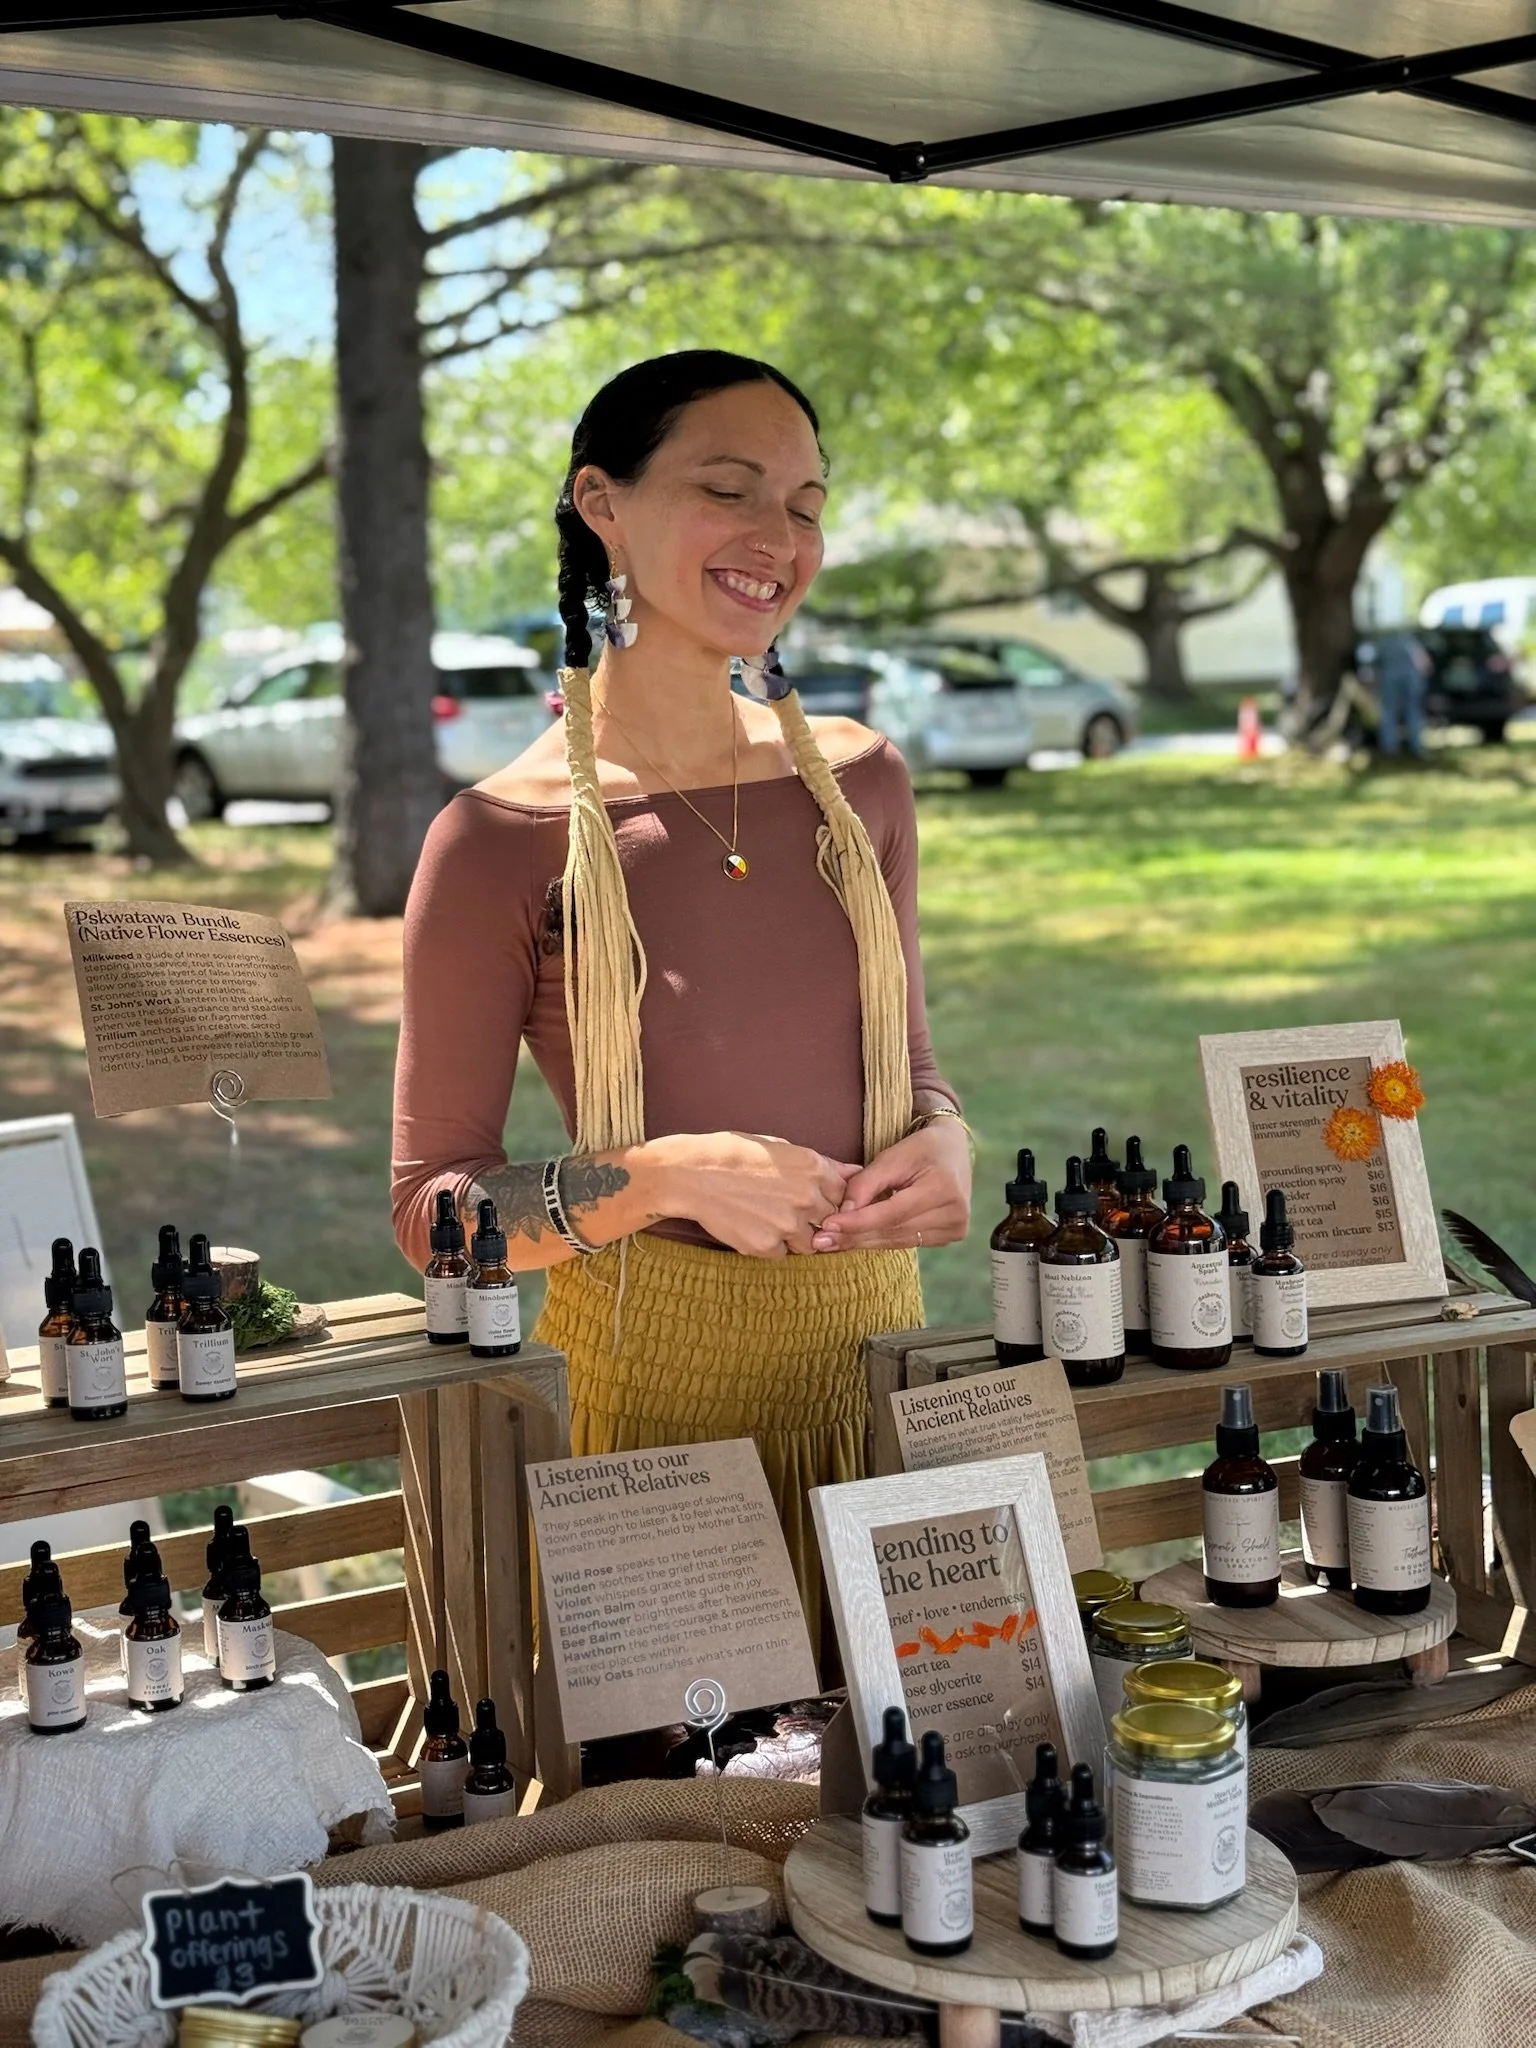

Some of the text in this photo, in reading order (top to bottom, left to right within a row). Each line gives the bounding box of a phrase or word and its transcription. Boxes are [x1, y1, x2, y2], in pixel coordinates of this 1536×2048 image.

[75, 910, 240, 929] Pskwatawa Bundle
[78, 926, 285, 948] (Native Flower Essences)
[82, 952, 133, 963] Milkweed
[145, 952, 172, 961] guide
[175, 951, 184, 959] of
[186, 951, 210, 959] inner
[90, 1003, 105, 1012] St.
[107, 1000, 142, 1010] John's
[145, 998, 172, 1006] Wort
[182, 996, 216, 1004] lantern
[220, 995, 229, 1003] in
[96, 1031, 138, 1042] Trillium
[140, 1026, 180, 1036] anchors
[251, 1022, 281, 1030] sacred
[1245, 1066, 1351, 1089] resilience
[1250, 1086, 1348, 1111] & vitality
[1252, 1116, 1320, 1130] inner strength
[1253, 1129, 1301, 1140] immunity
[1261, 1164, 1312, 1179] grounding
[1314, 1163, 1342, 1173] spray
[1263, 1170, 1385, 1192] protection spray $16
[1370, 1183, 1387, 1193] $16
[1300, 1196, 1389, 1214] oxymel $16
[1307, 1208, 1392, 1225] tea $15
[1332, 1226, 1371, 1237] tincture
[1378, 1221, 1395, 1232] $13
[193, 1339, 229, 1349] Trillium
[91, 1355, 113, 1363] Wort
[900, 1378, 1017, 1416] Listening to our
[905, 1393, 1032, 1434] Ancient Relatives
[909, 1407, 1056, 1448] Teachers in what true vitality feels like
[534, 1453, 689, 1488] Listening to our
[540, 1470, 711, 1510] Ancient Relatives
[543, 1493, 744, 1532] They speak in the language of slowing
[873, 1523, 1008, 1565] tending to
[552, 1570, 580, 1585] Wild
[584, 1566, 613, 1579] Rose
[616, 1557, 655, 1573] speaks
[657, 1555, 669, 1565] to
[671, 1552, 690, 1562] the
[692, 1545, 728, 1559] tender
[880, 1554, 1000, 1597] the heart
[553, 1582, 596, 1598] Linden
[599, 1574, 645, 1589] soothes
[647, 1569, 666, 1580] the
[668, 1563, 693, 1578] grief
[696, 1559, 719, 1570] that
[557, 1609, 601, 1624] Lemon
[604, 1602, 636, 1615] Balm
[639, 1598, 657, 1608] our
[660, 1590, 696, 1606] gentle
[699, 1583, 731, 1598] guide
[733, 1580, 744, 1590] in
[889, 1592, 1027, 1629] rief love tenderness
[563, 1610, 801, 1663] Hawthorn the elder tree that protects the
[1018, 1638, 1037, 1654] $15
[146, 1645, 166, 1655] Oak
[48, 1667, 75, 1678] Kowa
[567, 1676, 601, 1689] Milky
[604, 1669, 634, 1682] Oats
[636, 1658, 694, 1677] nourishes
[695, 1648, 732, 1664] what's
[734, 1643, 763, 1656] worn
[930, 1659, 951, 1672] tea
[1021, 1657, 1041, 1673] $14
[905, 1672, 1045, 1698] ose glycerite $14
[908, 1692, 994, 1719] lower essence
[953, 1730, 974, 1741] are
[1024, 1711, 1050, 1726] only
[955, 1744, 976, 1759] ask
[979, 1743, 990, 1754] to
[171, 1930, 288, 1970] offerings
[215, 1962, 255, 1991] $3
